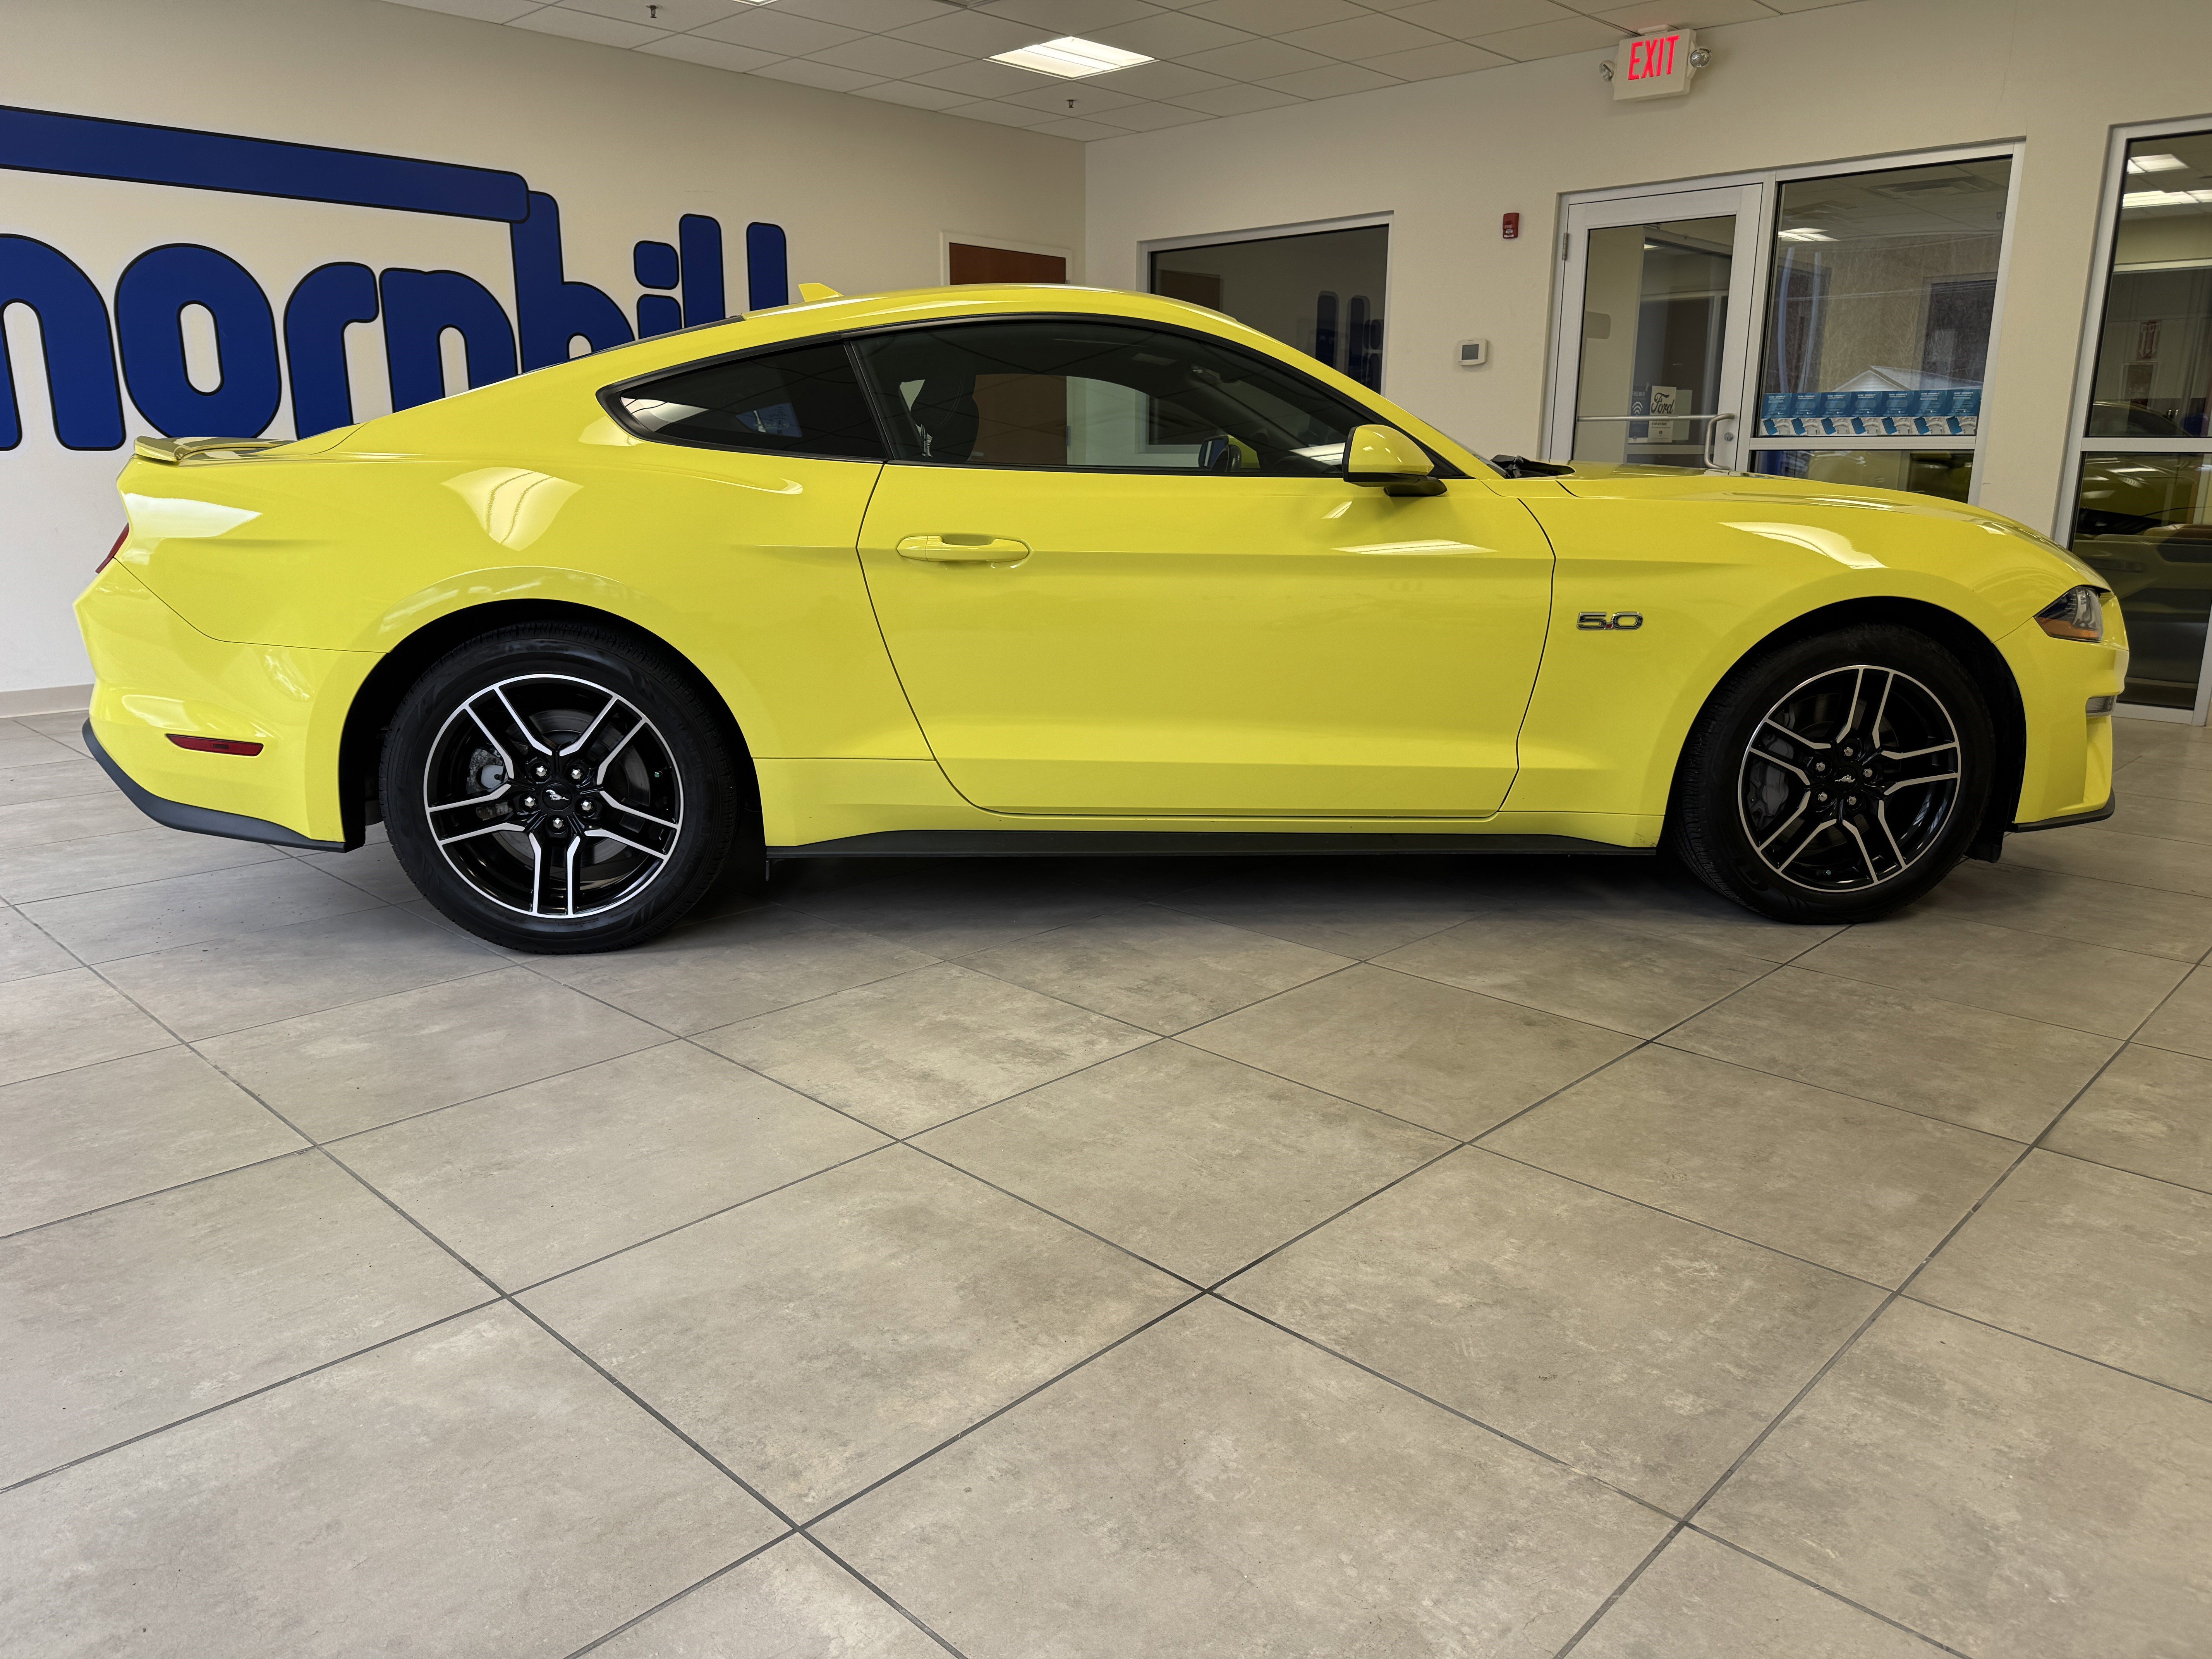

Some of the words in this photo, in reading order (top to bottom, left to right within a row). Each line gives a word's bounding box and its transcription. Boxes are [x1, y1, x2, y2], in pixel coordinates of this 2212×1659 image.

[1628, 35, 1680, 80] EXIT
[1651, 392, 1675, 414] Ford
[1576, 611, 1644, 630] 5.0
